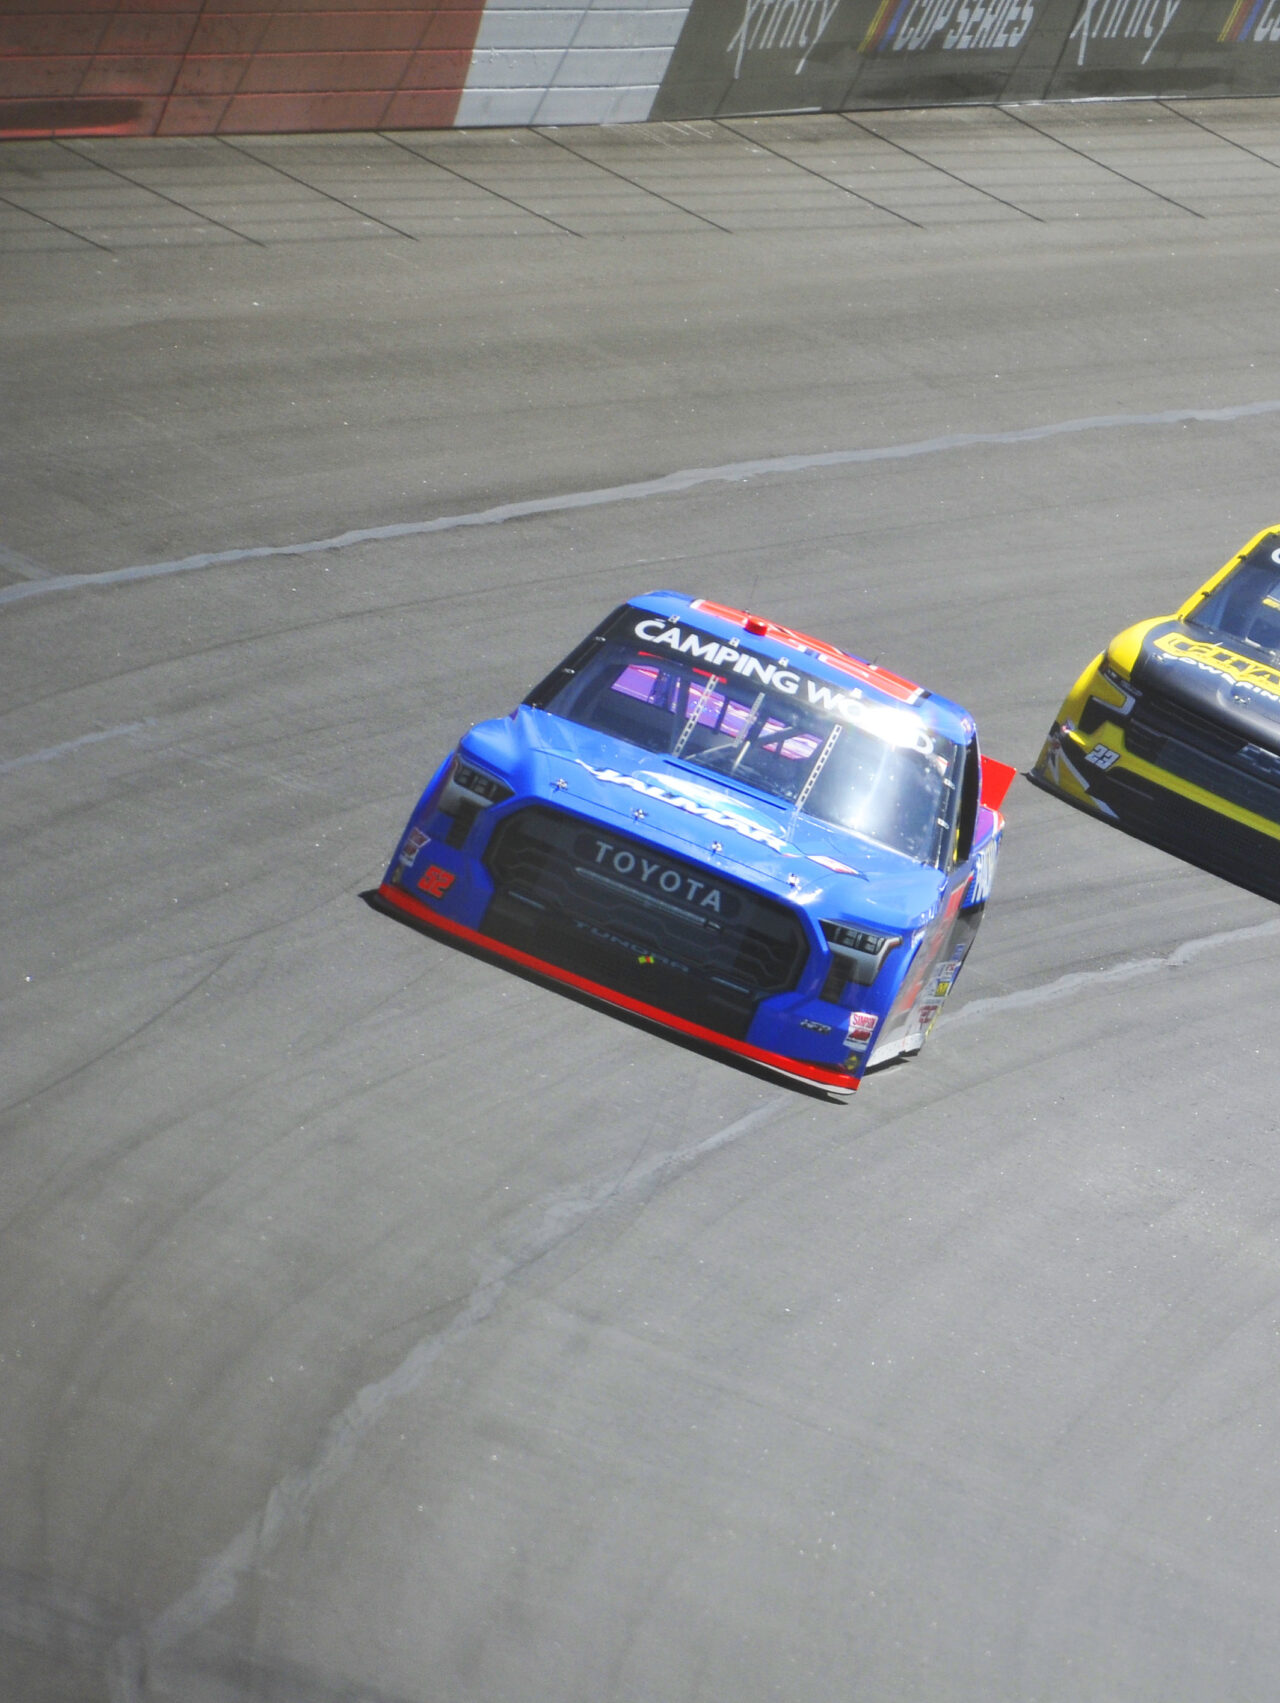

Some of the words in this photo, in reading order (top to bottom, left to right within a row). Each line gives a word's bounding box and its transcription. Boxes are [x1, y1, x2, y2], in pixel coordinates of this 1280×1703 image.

[634, 618, 800, 695] CAMPING
[807, 680, 934, 756] WOD
[1084, 743, 1120, 770] 23
[417, 865, 456, 899] 52
[595, 840, 722, 913] TOYOTA
